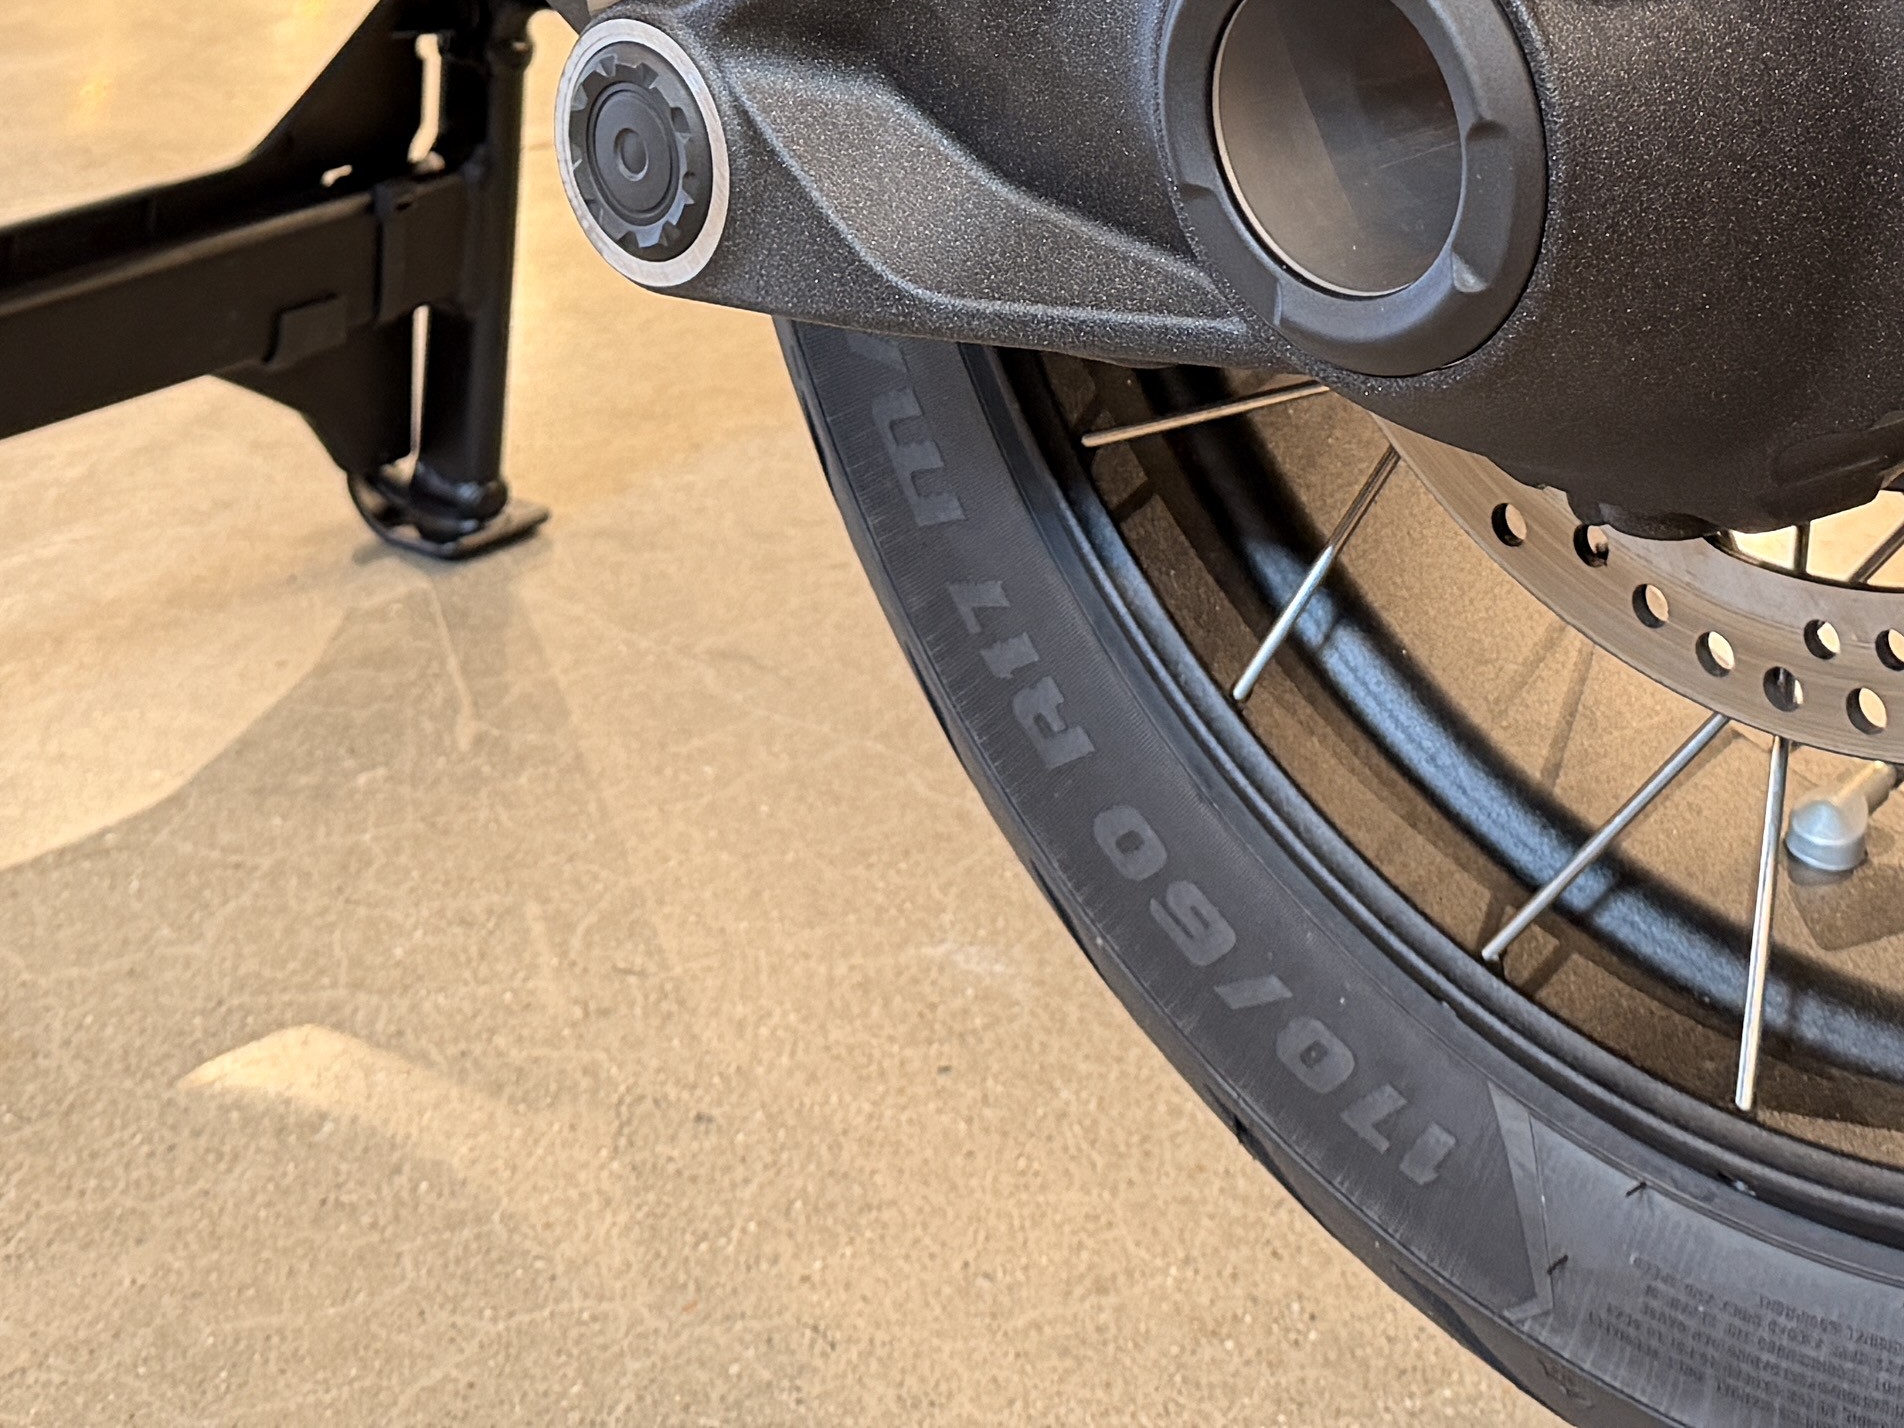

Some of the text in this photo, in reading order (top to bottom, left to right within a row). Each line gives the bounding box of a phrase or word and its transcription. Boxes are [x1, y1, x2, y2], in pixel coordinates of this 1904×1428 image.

[848, 331, 1460, 1187] 170/60 R17 M/
